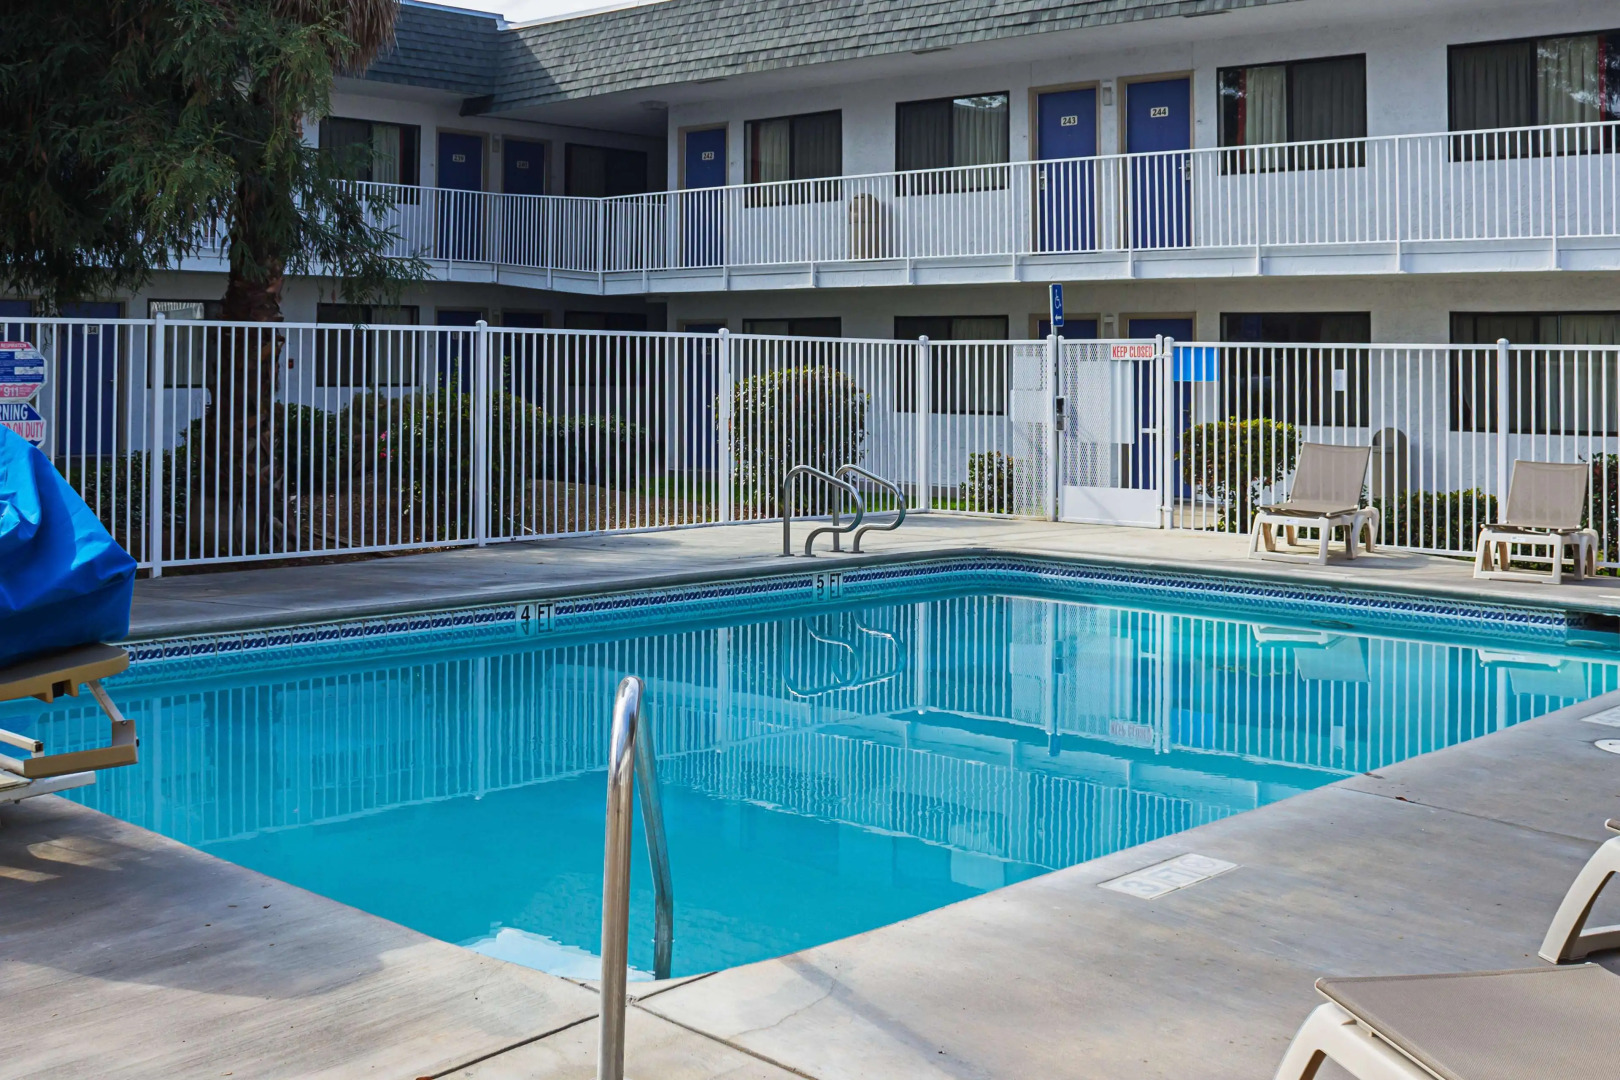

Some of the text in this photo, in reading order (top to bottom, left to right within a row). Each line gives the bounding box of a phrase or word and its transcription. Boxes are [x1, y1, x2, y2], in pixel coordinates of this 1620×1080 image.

[1152, 107, 1167, 117] 244
[1062, 116, 1076, 125] 243
[1112, 345, 1153, 358] KEEP CLOSED
[3, 386, 19, 397] 911
[0, 404, 28, 420] NING
[26, 421, 44, 438] DUTY
[817, 572, 841, 589] 5 FT
[521, 603, 553, 621] 4 FT
